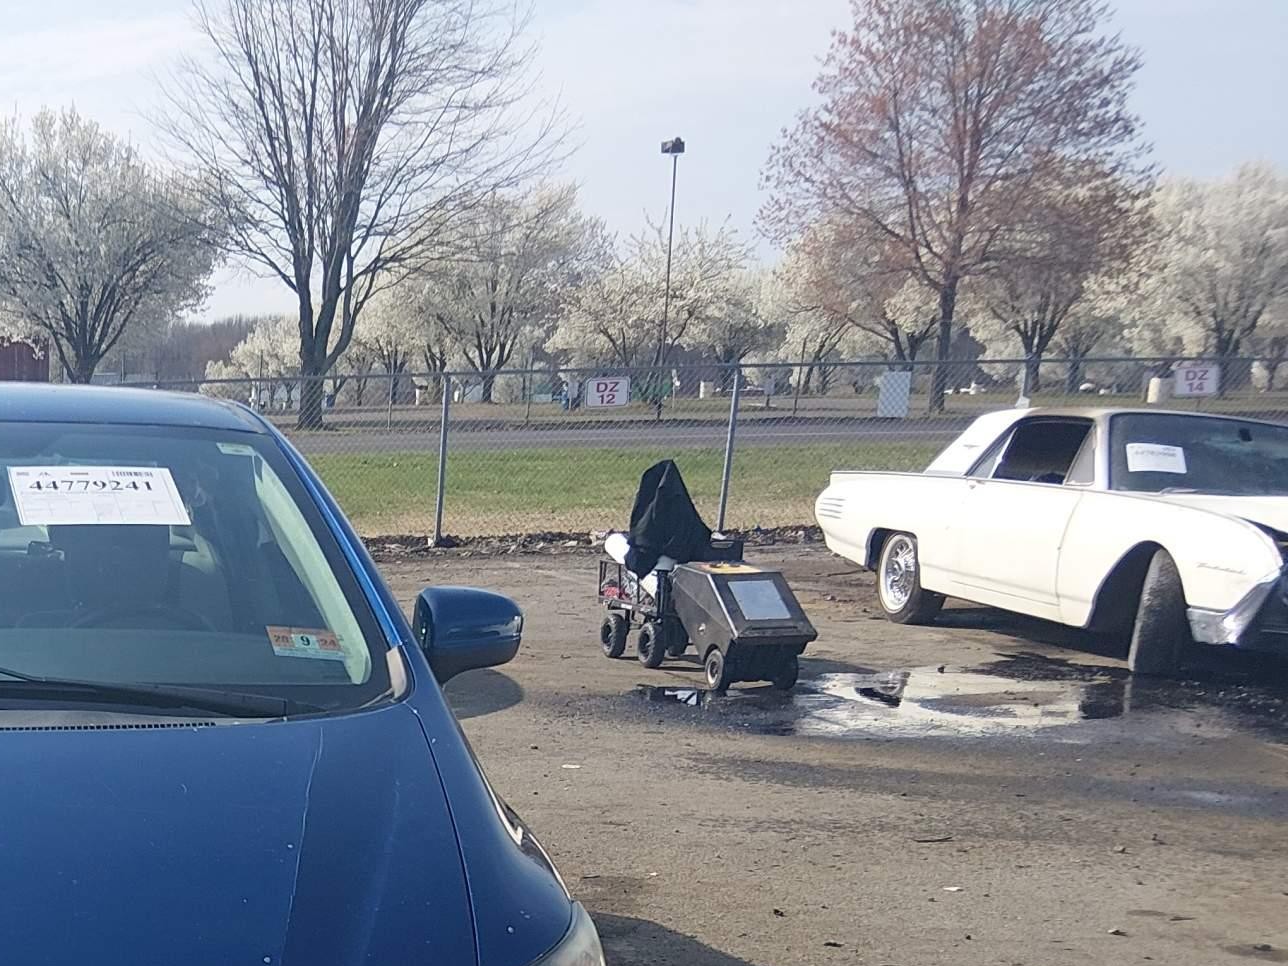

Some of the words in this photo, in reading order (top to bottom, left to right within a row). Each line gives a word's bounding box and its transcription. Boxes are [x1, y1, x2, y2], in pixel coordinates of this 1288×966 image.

[1185, 369, 1209, 381] DZ
[596, 382, 620, 393] DZ
[1187, 382, 1204, 392] 14
[599, 394, 615, 404] 12
[29, 480, 152, 491] 44779241
[300, 635, 311, 646] 9
